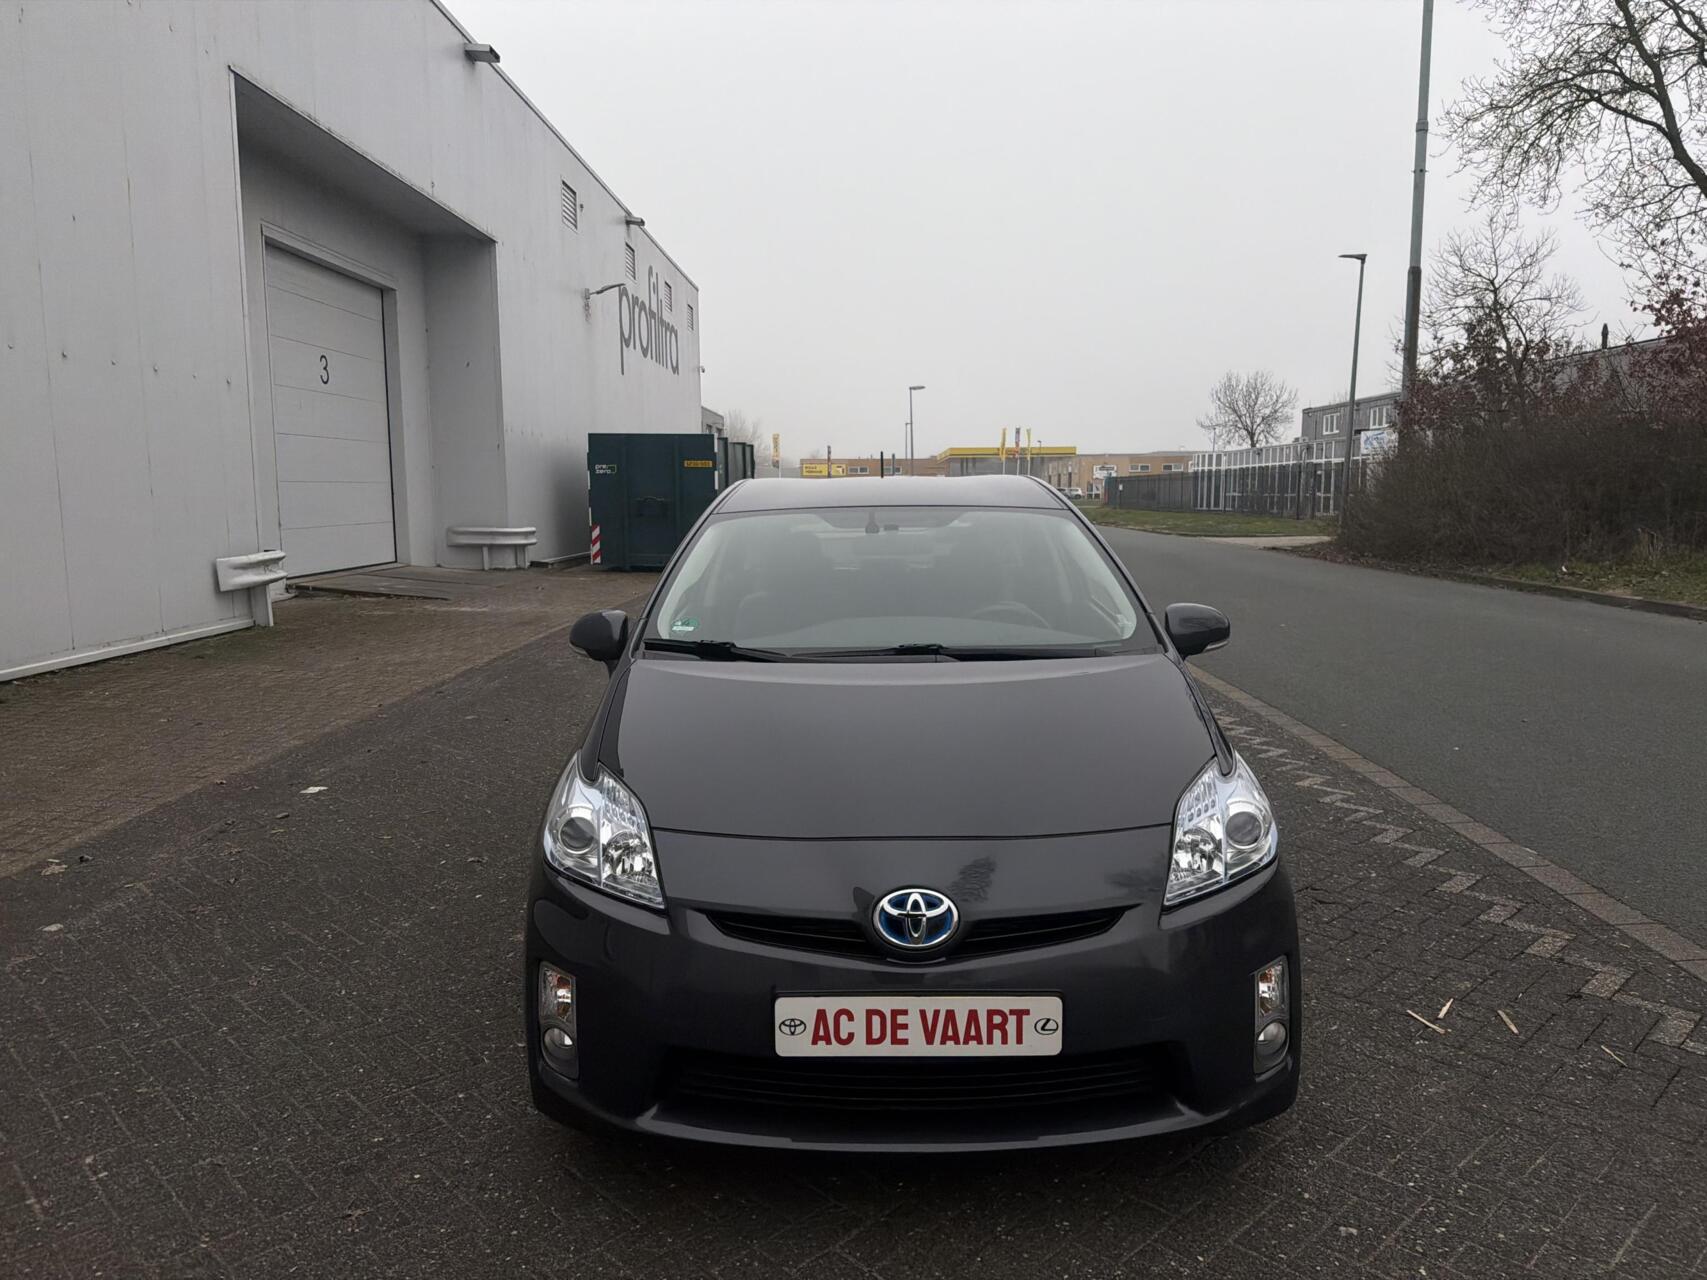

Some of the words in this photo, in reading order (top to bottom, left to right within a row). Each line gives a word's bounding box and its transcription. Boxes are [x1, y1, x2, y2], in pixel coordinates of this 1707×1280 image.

[619, 265, 680, 375] profiltra
[320, 354, 330, 385] 3
[811, 1008, 855, 1046] AC
[865, 1008, 908, 1046] DE
[919, 1008, 1031, 1046] VAART
